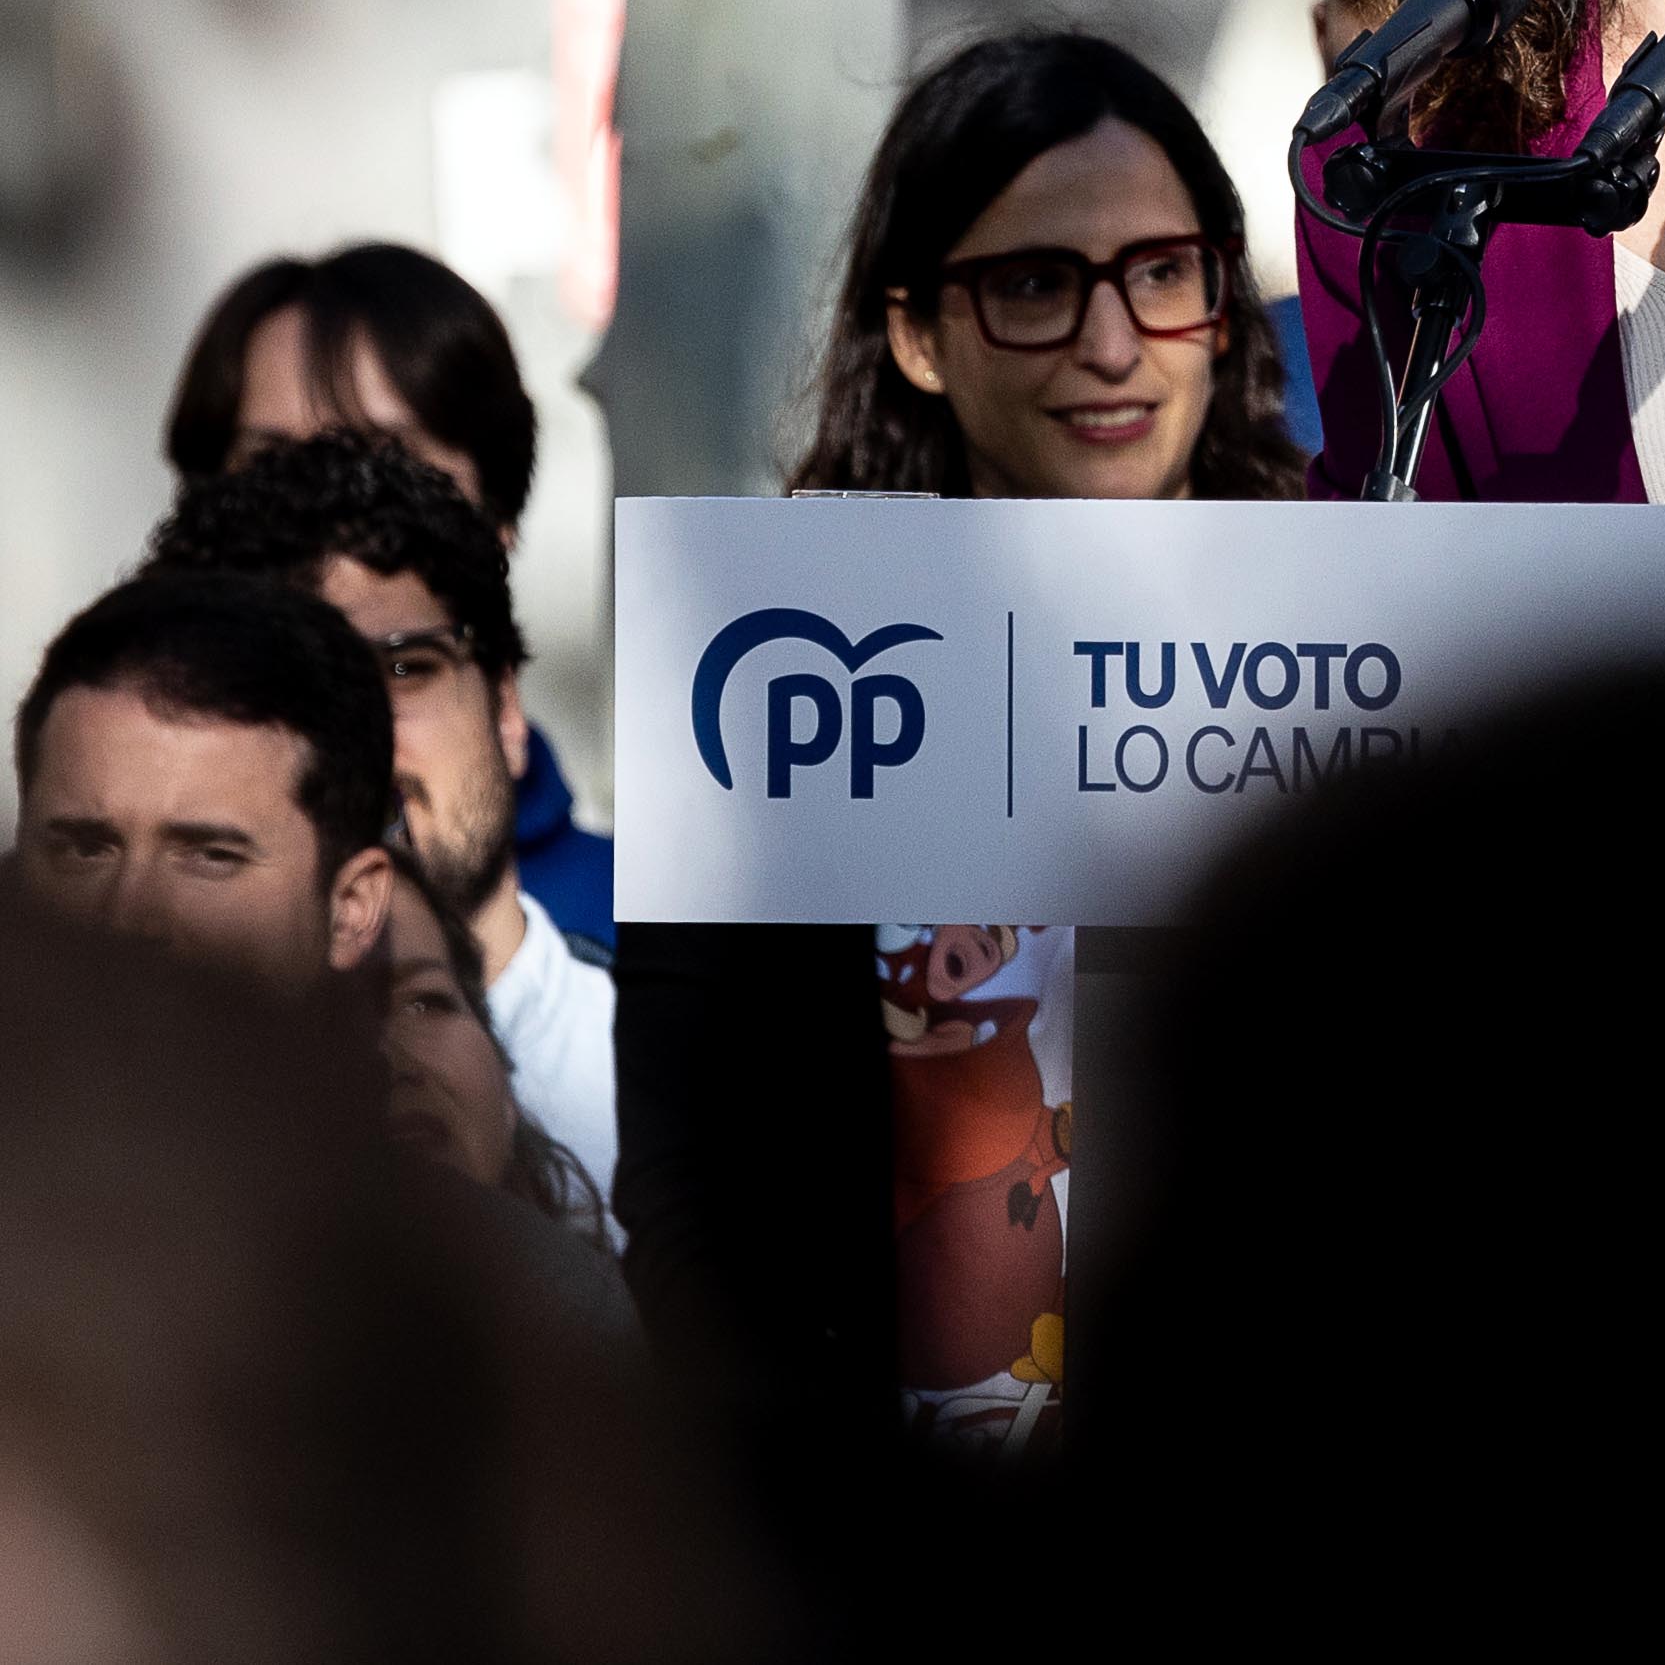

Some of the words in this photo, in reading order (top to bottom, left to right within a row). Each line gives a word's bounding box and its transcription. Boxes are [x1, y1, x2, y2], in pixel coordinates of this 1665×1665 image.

[1073, 642, 1177, 709] TU
[1192, 642, 1402, 712] VOTO
[1078, 725, 1169, 793] LO
